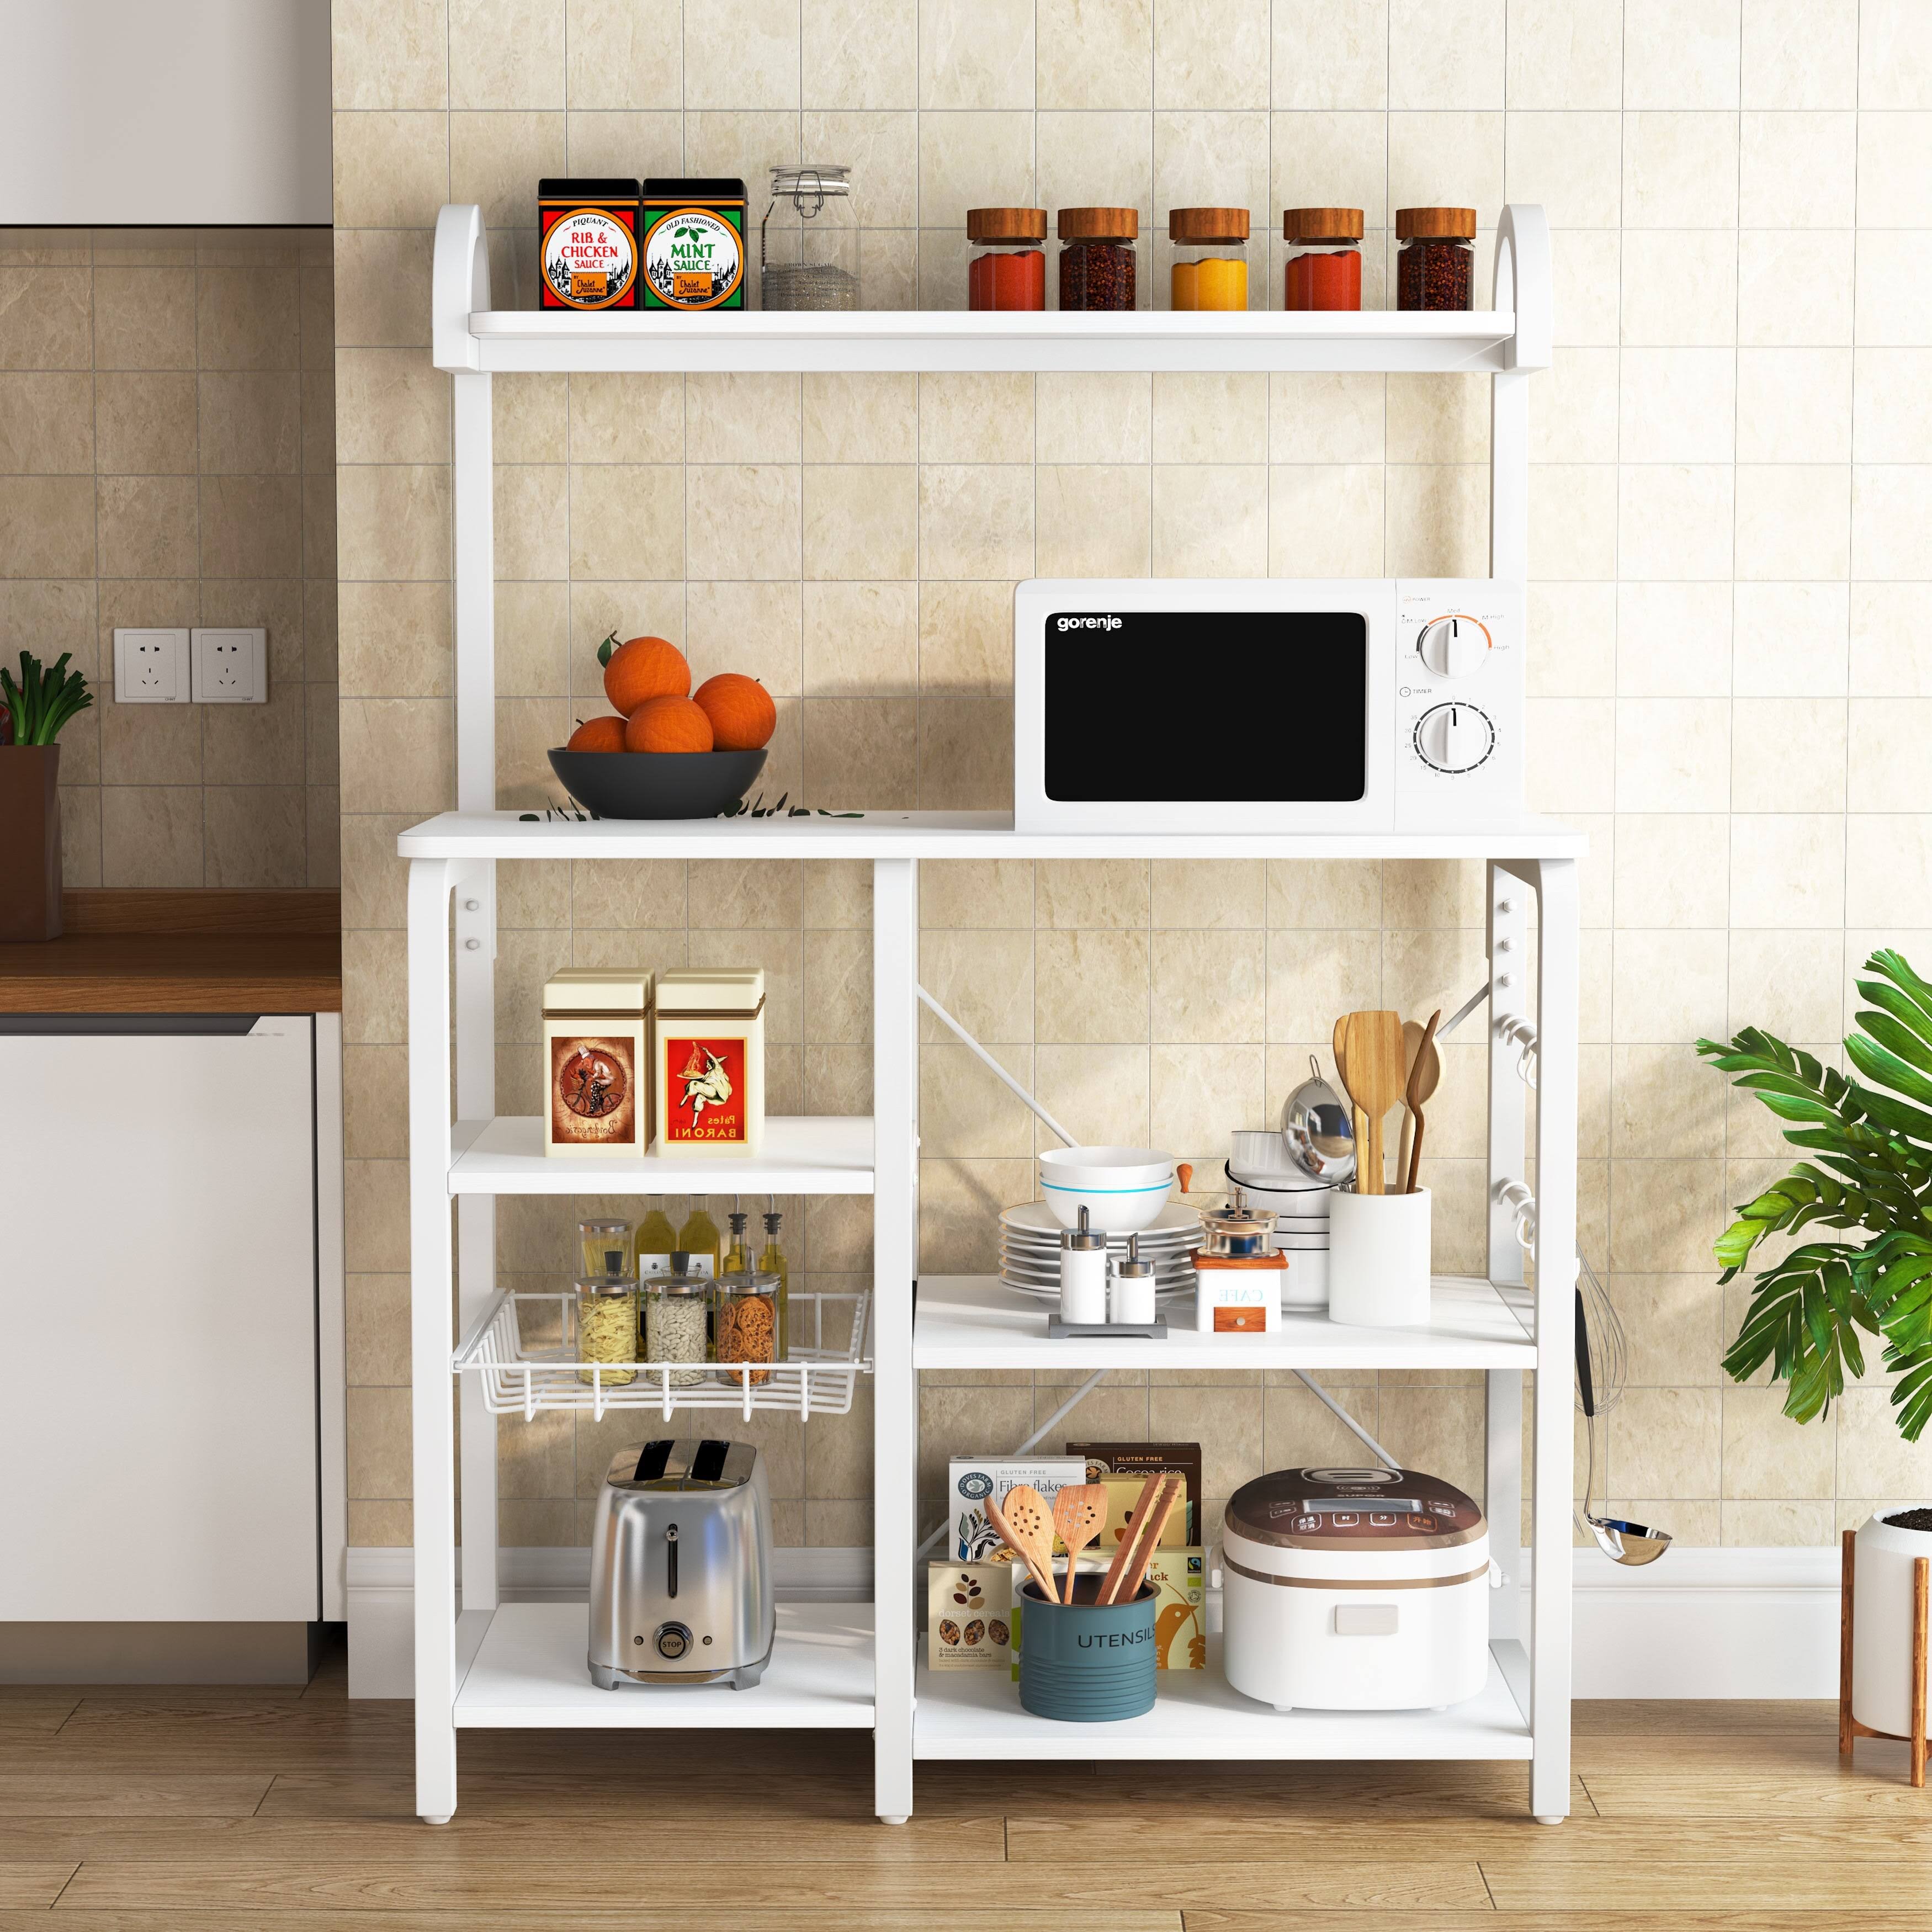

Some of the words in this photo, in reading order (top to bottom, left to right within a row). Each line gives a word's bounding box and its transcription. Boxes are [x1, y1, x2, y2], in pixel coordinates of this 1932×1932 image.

[572, 217, 608, 227] PIQUANT
[666, 220, 680, 231] OLD
[681, 217, 720, 231] FASHIONED
[571, 232, 594, 243] RIB
[598, 232, 608, 244] &
[561, 246, 618, 258] CHICKEN
[671, 243, 715, 258] MINT
[575, 260, 604, 268] SAUCE
[673, 260, 712, 270] SAUCE
[577, 279, 595, 288] Chalet
[680, 279, 699, 288] Chalet
[1057, 614, 1122, 631] gorenje
[960, 1474, 976, 1487] DOVES
[978, 1474, 991, 1487] FARM
[962, 1489, 990, 1499] ORGANIC
